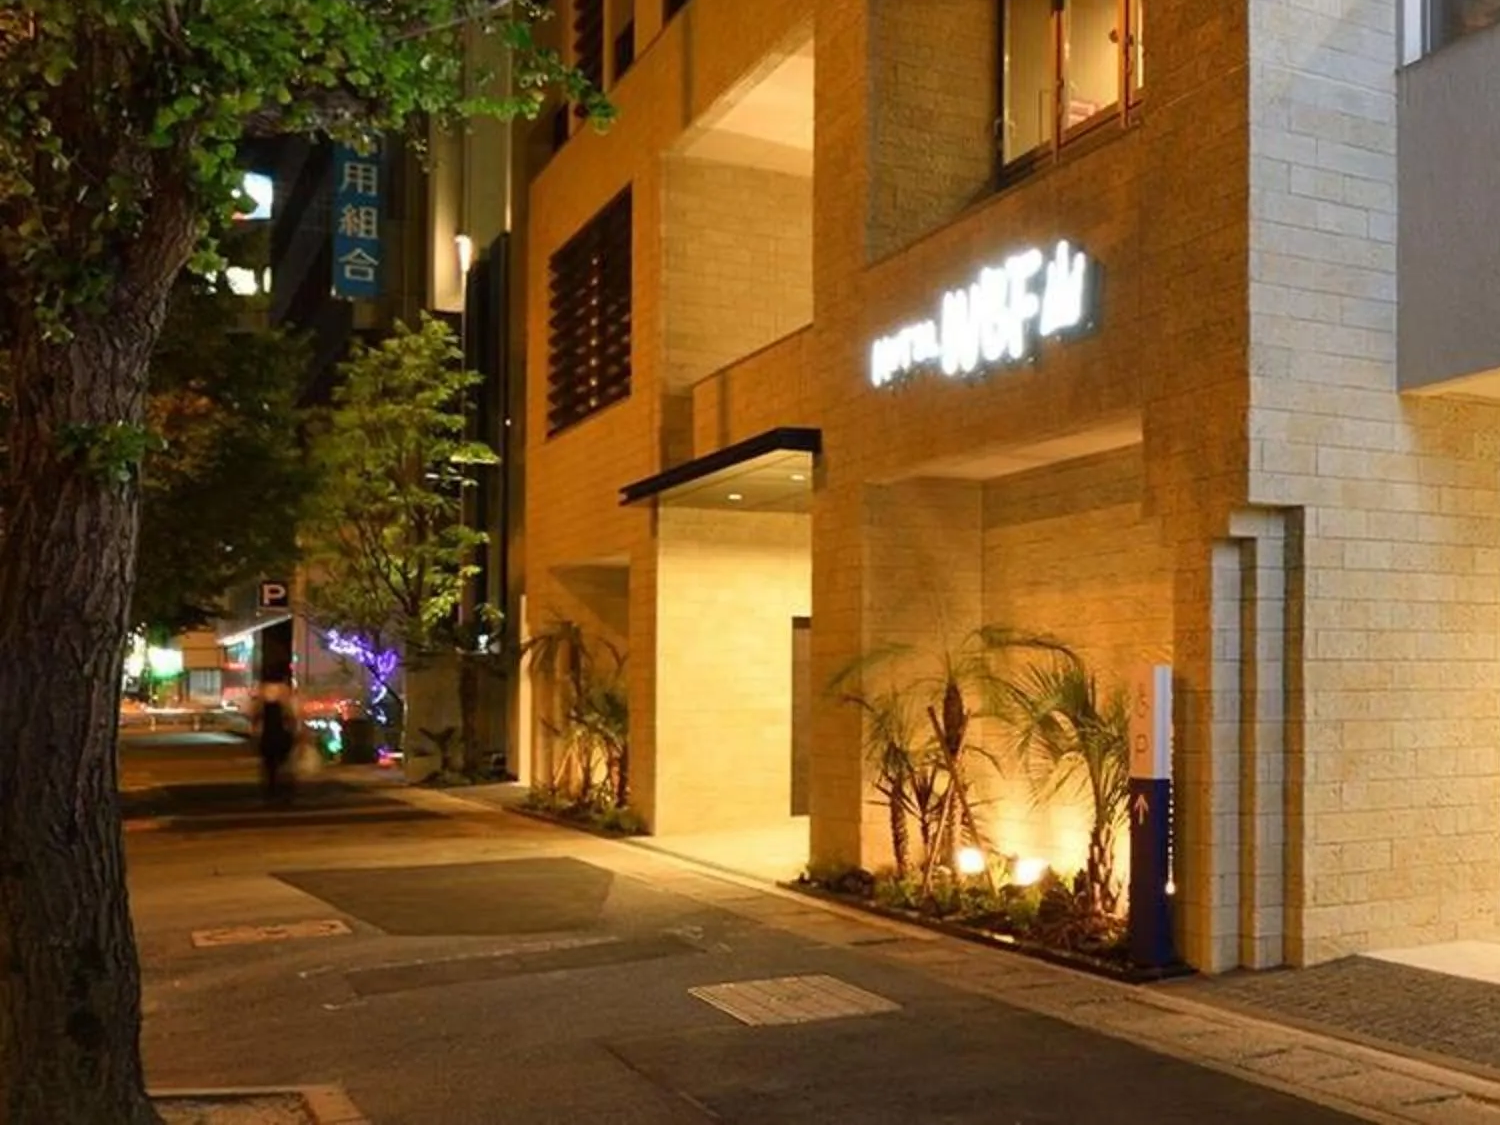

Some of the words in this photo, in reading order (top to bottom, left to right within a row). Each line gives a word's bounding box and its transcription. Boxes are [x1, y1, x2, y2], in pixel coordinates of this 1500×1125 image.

[338, 133, 379, 282] 用組合
[263, 584, 286, 605] P
